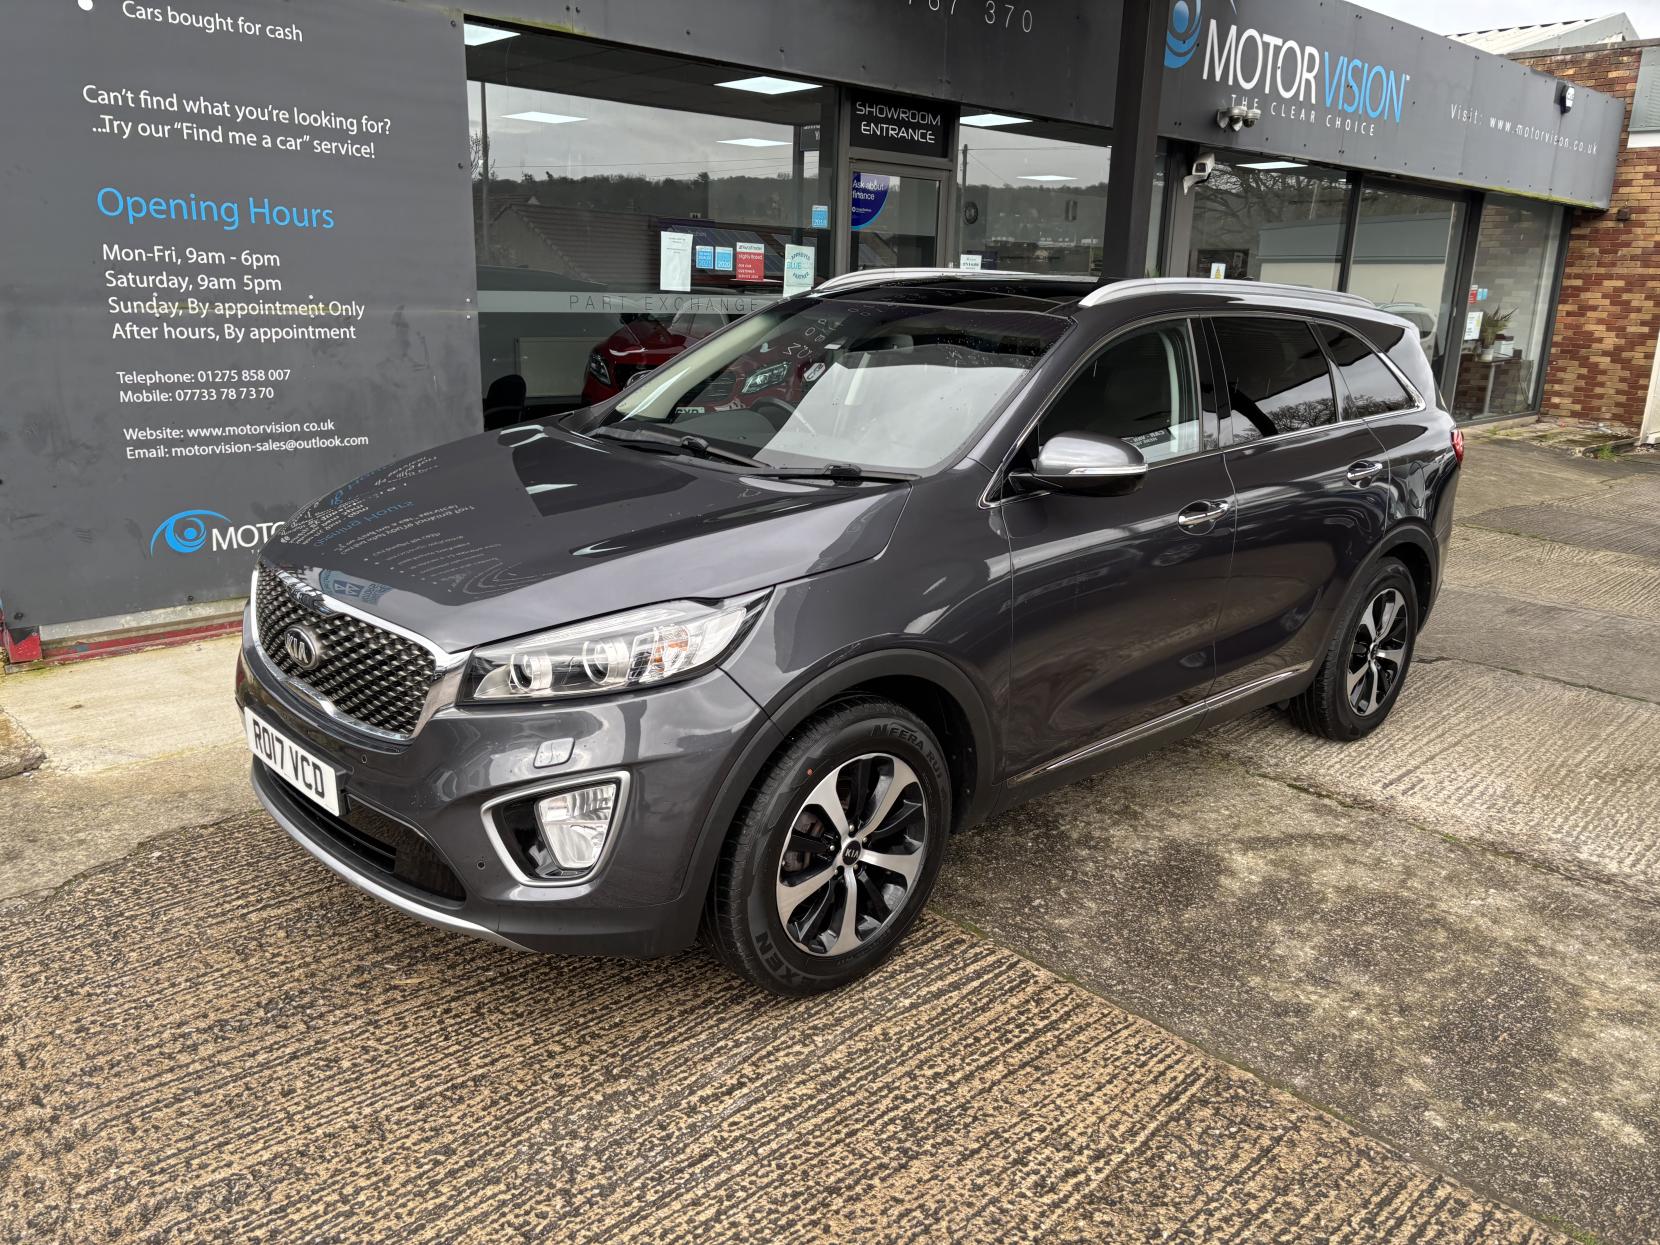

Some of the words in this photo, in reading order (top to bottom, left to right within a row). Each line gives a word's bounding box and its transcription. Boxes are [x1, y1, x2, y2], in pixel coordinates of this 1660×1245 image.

[122, 1, 163, 22] Cars
[167, 6, 234, 33] bought
[237, 16, 262, 36] for
[266, 24, 303, 42] cash
[985, 1, 1032, 32] 370
[82, 85, 134, 107] Can't
[139, 90, 178, 112] find
[183, 97, 231, 117] what
[234, 105, 290, 123] you're
[293, 107, 357, 134] looking
[361, 115, 391, 135] for?
[855, 101, 941, 126] SHOWROOM
[1271, 102, 1315, 124] CLEAR
[1326, 114, 1375, 136] CHOICE
[137, 122, 171, 138] our
[228, 128, 257, 147] me
[262, 134, 272, 148] a
[313, 139, 376, 159] service!
[861, 122, 936, 143] ENTRANCE
[97, 187, 240, 231] Opening
[248, 197, 335, 229] Hours
[102, 244, 181, 265] Mon-Fri,
[186, 248, 226, 265] 9am
[241, 250, 280, 270] 6pm
[105, 270, 193, 292] Saturday,
[197, 274, 236, 290] 9am
[243, 275, 282, 294] 5pm
[108, 296, 182, 318] Sunday,
[188, 298, 209, 318] By
[214, 301, 324, 319] appointment
[328, 301, 365, 320] Only
[569, 295, 627, 310] PART
[644, 296, 758, 311] EXCHANGE
[112, 323, 158, 340] After
[163, 322, 220, 342] hours,
[225, 324, 245, 343] By
[250, 325, 356, 343] appointment
[116, 371, 194, 386] Telephone:
[198, 370, 238, 383] 01275
[242, 369, 266, 382] 858
[268, 369, 291, 381] 007
[119, 389, 173, 403] Mobile:
[175, 389, 217, 402] 07733
[220, 388, 237, 400] 78
[124, 427, 184, 441] Website:
[126, 445, 169, 459] Email:
[172, 434, 369, 457] motorvision-sales@outlook.com
[286, 632, 309, 663] KIA
[252, 718, 284, 771] RO17
[289, 745, 325, 799] VCD
[845, 849, 860, 858] KIA
